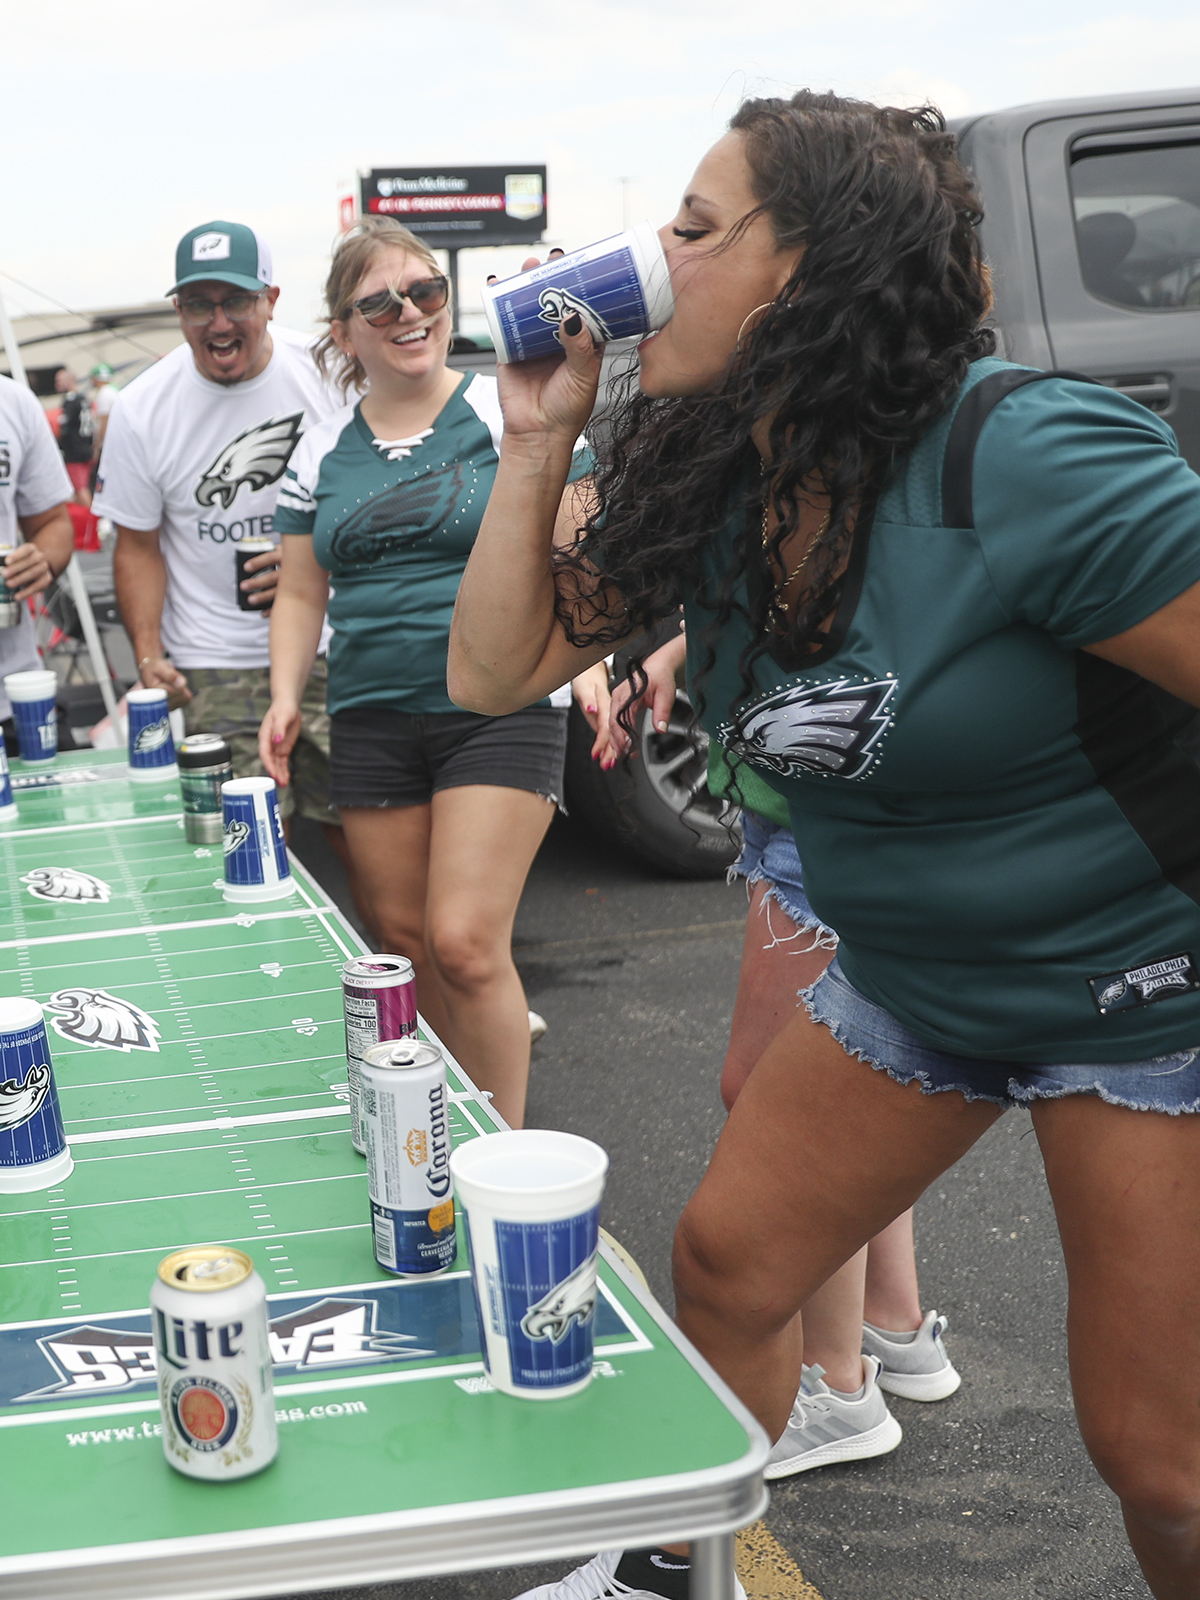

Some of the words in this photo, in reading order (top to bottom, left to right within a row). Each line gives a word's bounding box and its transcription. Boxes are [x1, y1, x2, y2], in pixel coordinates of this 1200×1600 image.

[1128, 958, 1187, 982] PHILADELPHIA
[1141, 972, 1188, 997] EAGLES
[361, 999, 375, 1007] Facts
[364, 1020, 377, 1028] 100
[425, 1083, 451, 1198] Corona
[154, 1305, 244, 1370] Lite
[195, 1376, 235, 1410] PILSNER
[191, 1439, 221, 1452] BEER
